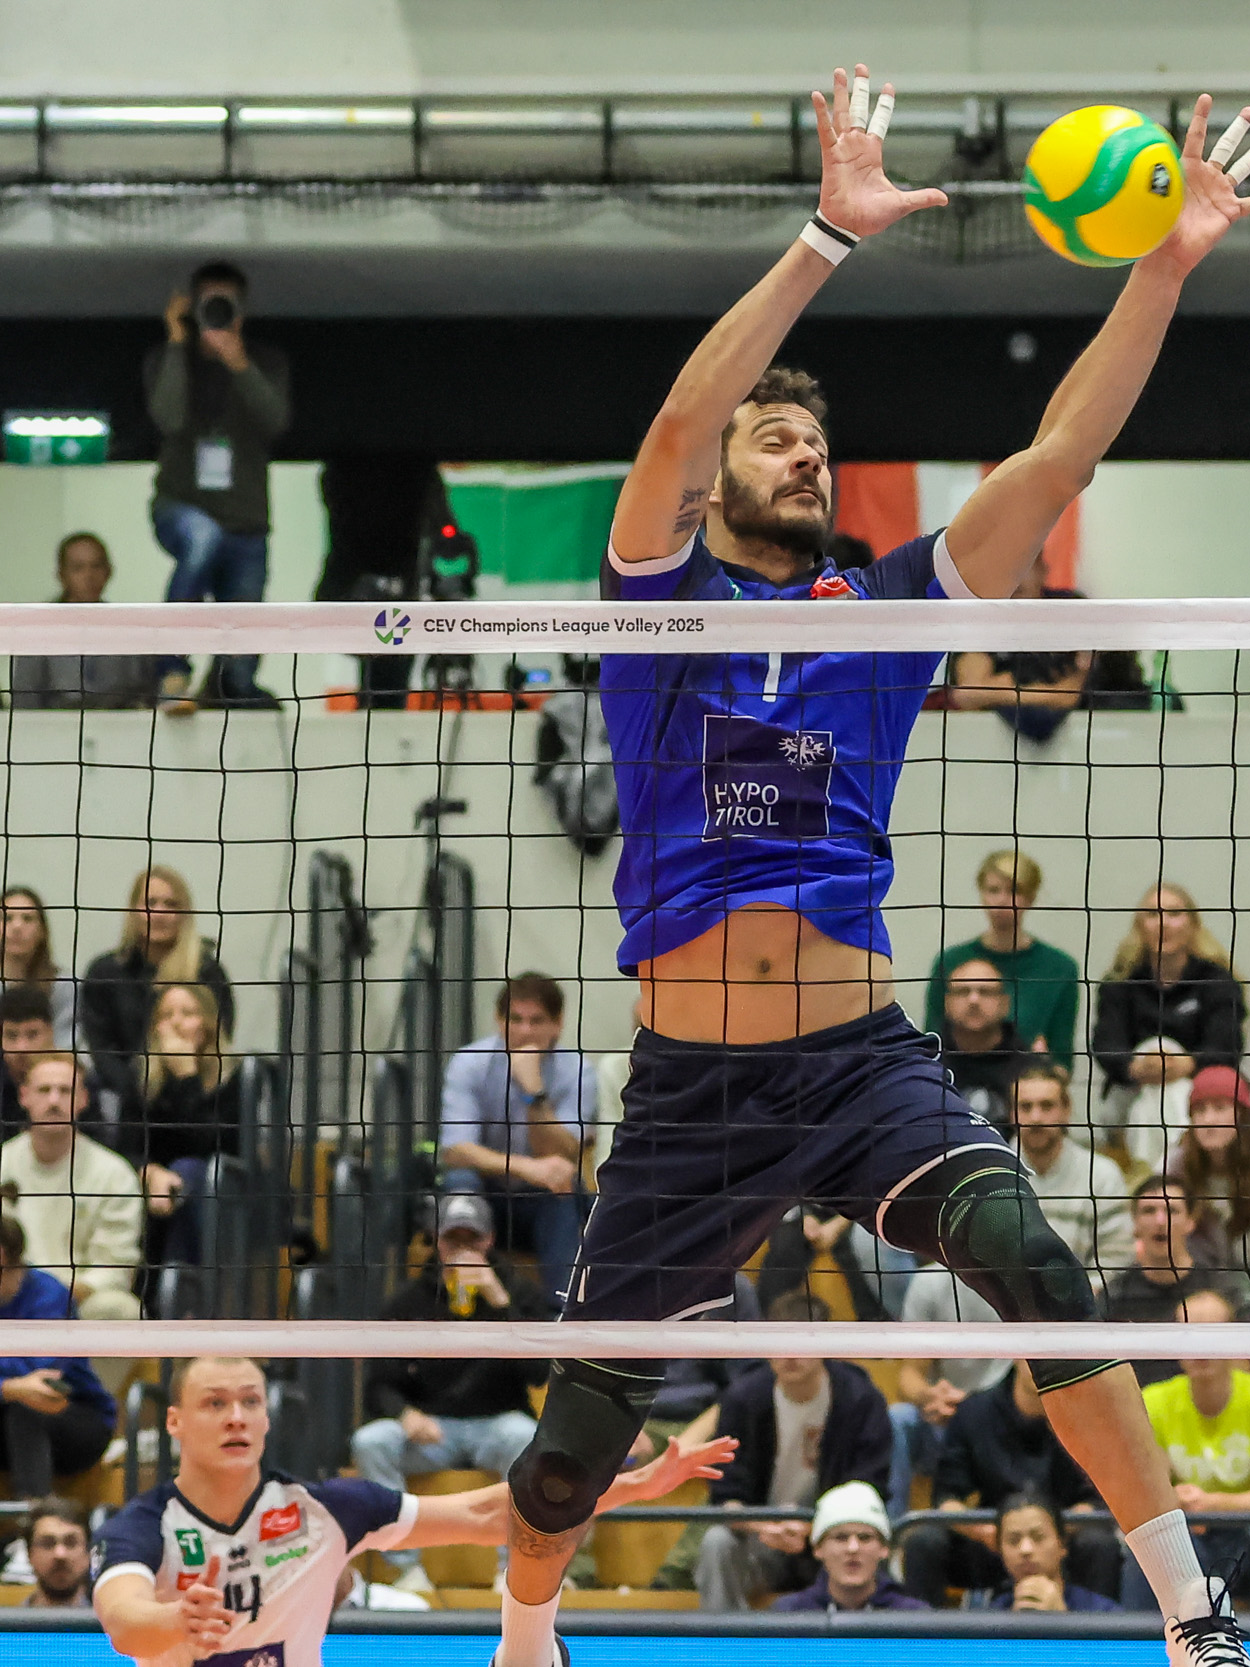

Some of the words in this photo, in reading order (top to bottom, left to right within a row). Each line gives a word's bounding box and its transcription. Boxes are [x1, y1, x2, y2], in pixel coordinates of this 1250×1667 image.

[423, 618, 456, 632] CEV
[460, 617, 548, 635] Champions
[552, 618, 610, 635] League
[614, 618, 663, 635] Volley
[667, 618, 704, 632] 2025
[714, 782, 780, 805] HYPO
[714, 805, 780, 827] TIROL
